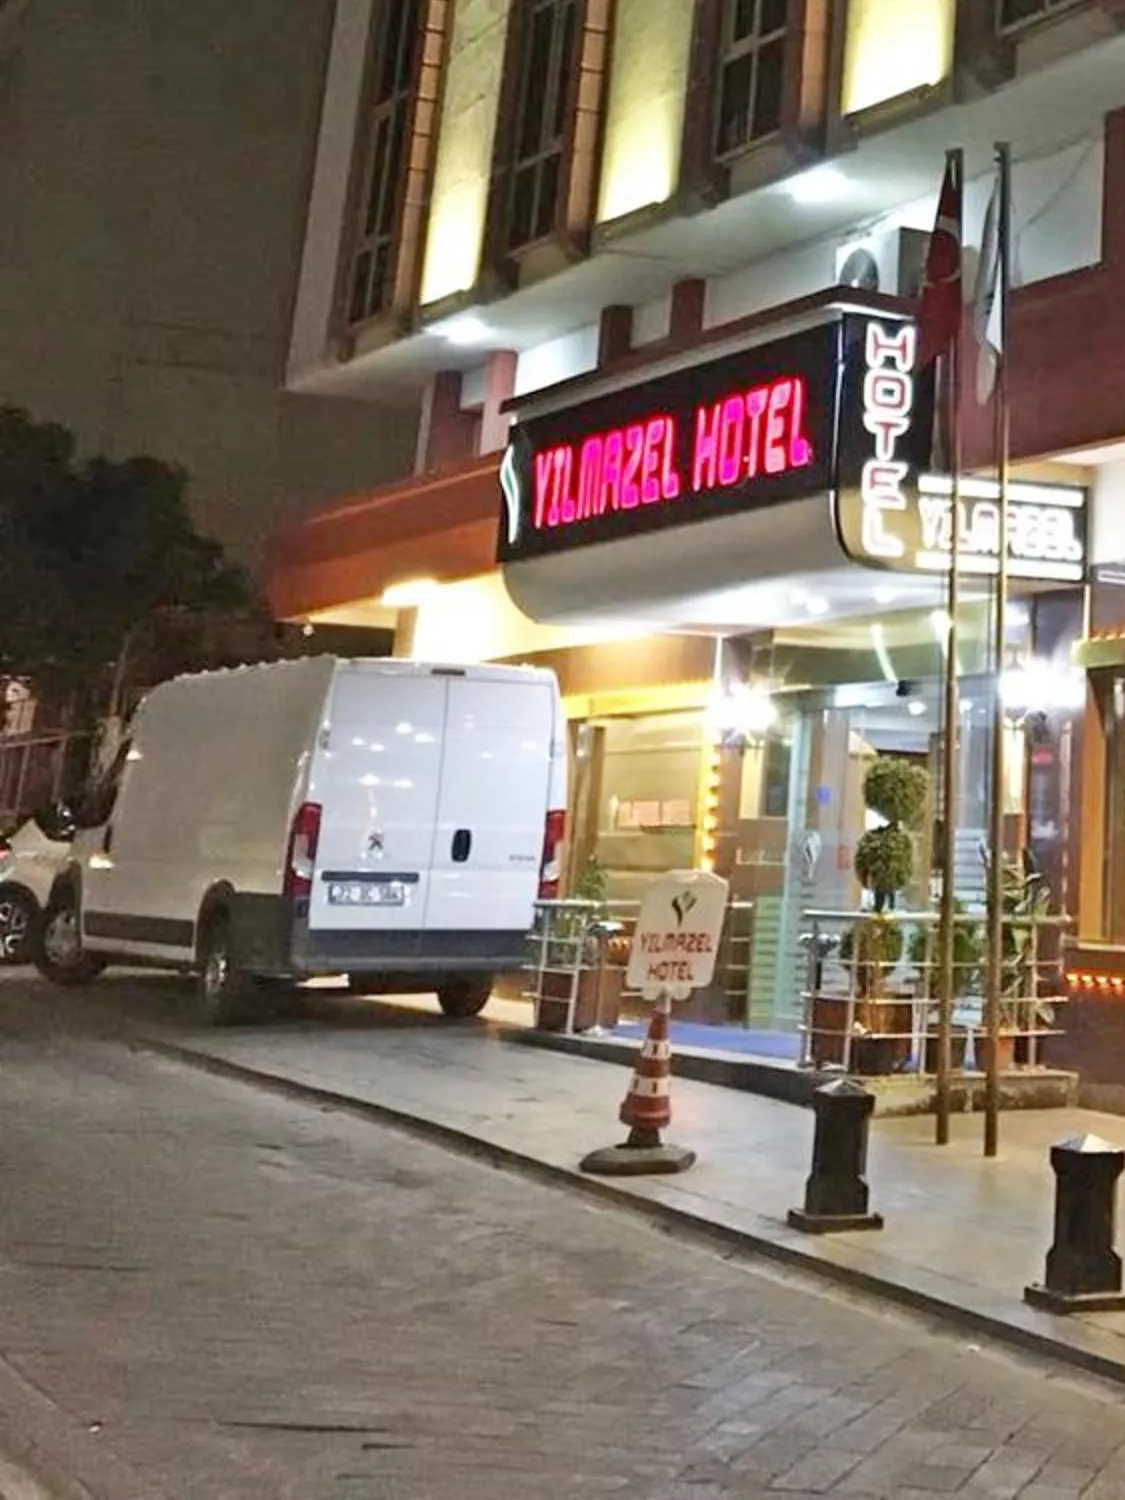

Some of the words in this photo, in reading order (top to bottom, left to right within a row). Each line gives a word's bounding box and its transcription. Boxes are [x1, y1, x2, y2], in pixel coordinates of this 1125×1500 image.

[533, 414, 681, 531] YILMAZEL
[692, 376, 808, 493] HOTEL
[864, 321, 916, 558] HOTEL
[640, 931, 713, 954] YILMAZEL
[646, 960, 695, 981] HOTEL
